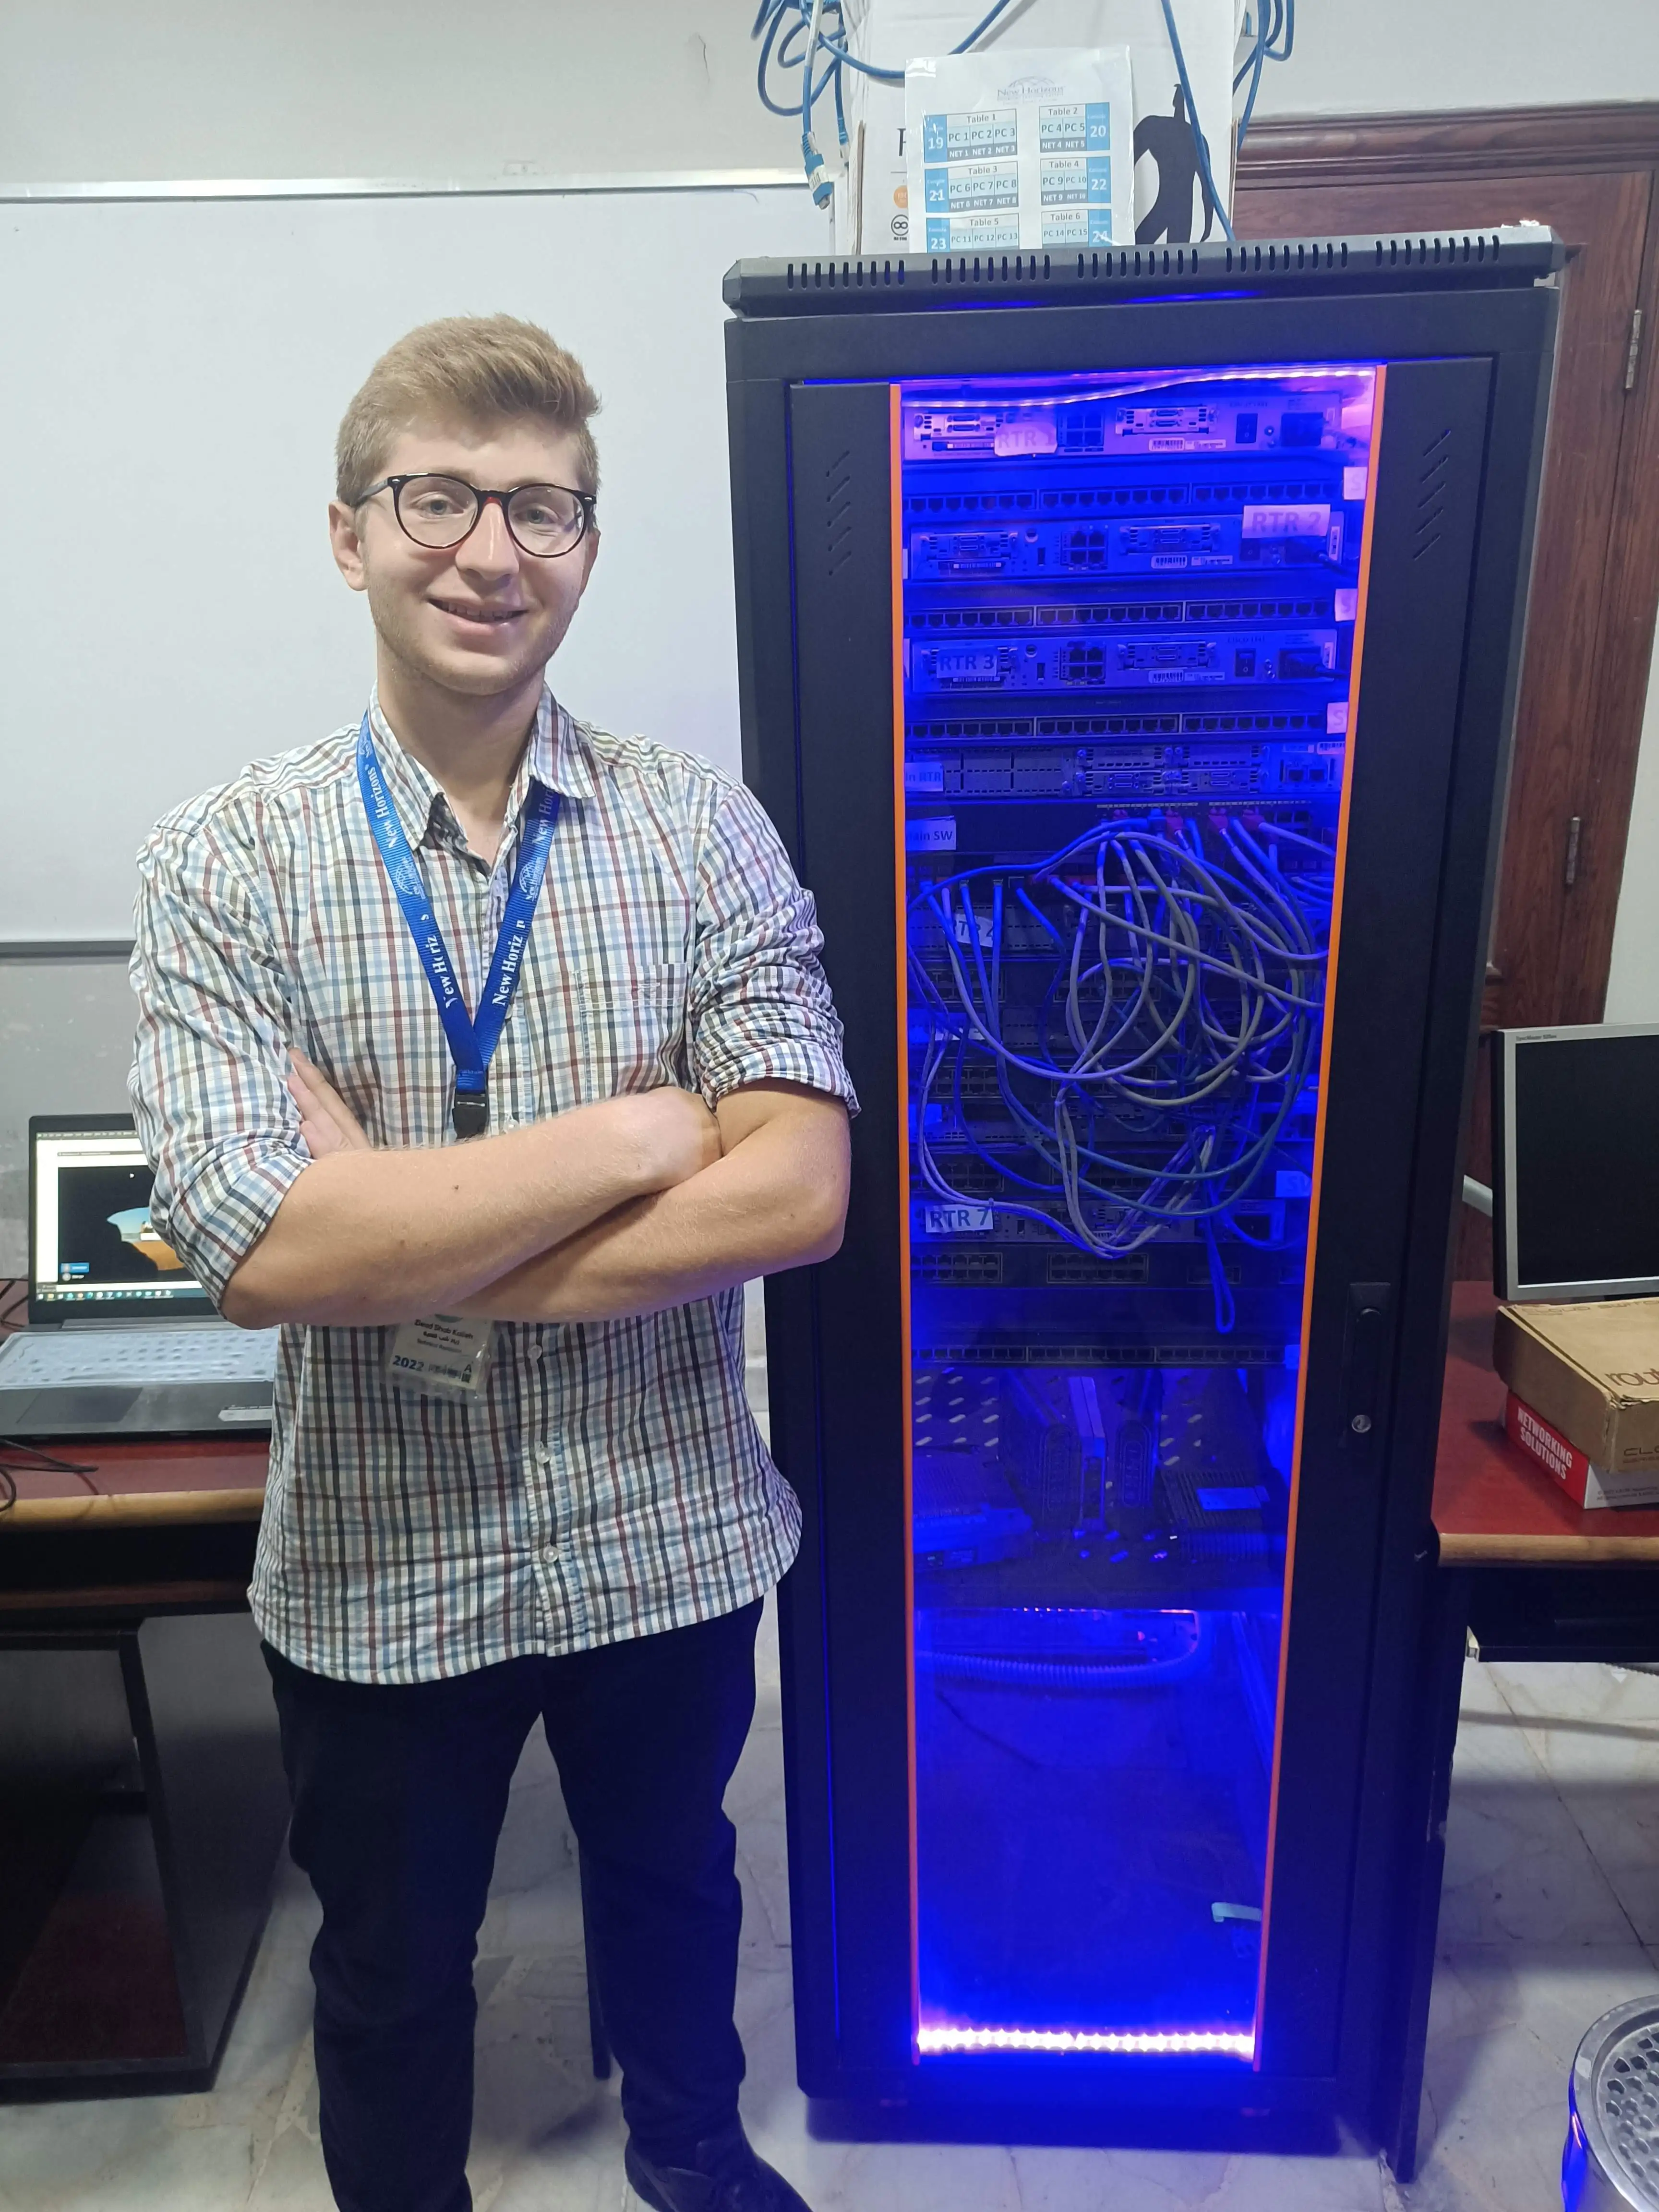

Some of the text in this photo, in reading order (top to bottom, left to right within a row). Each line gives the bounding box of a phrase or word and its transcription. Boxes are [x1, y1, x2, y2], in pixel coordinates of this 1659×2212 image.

[967, 115, 988, 123] Table
[1042, 124, 1054, 133] PC
[1057, 124, 1061, 132] 4
[1065, 123, 1076, 132] PC
[1090, 125, 1106, 138] 20
[949, 133, 960, 142] PC
[972, 131, 983, 140] PC
[987, 130, 992, 138] 2
[995, 129, 1007, 137] PC
[1010, 128, 1015, 136] 3
[928, 137, 944, 149] 19
[968, 166, 990, 175] Table
[950, 184, 962, 193] PC
[974, 182, 985, 191] PC
[988, 181, 993, 190] 7
[997, 180, 1008, 189] PC
[1011, 180, 1016, 188] 8
[1043, 177, 1055, 186] PC
[1058, 177, 1063, 185] 9
[1091, 179, 1106, 190] 22
[929, 189, 945, 201] 21
[1093, 230, 1108, 242] 24
[931, 238, 946, 249] 23
[998, 430, 1037, 449] RTR
[1251, 511, 1322, 534] RTR 2
[940, 654, 995, 671] RTR 3
[919, 771, 941, 782] RTR
[368, 766, 398, 849] New Horizons
[532, 817, 550, 844] New
[934, 830, 953, 841] SW
[492, 974, 513, 1007] New
[929, 1208, 989, 1227] RTR 7
[1517, 1407, 1573, 1469] NETWORKING
[1521, 1427, 1566, 1479] SOLUTIONS
